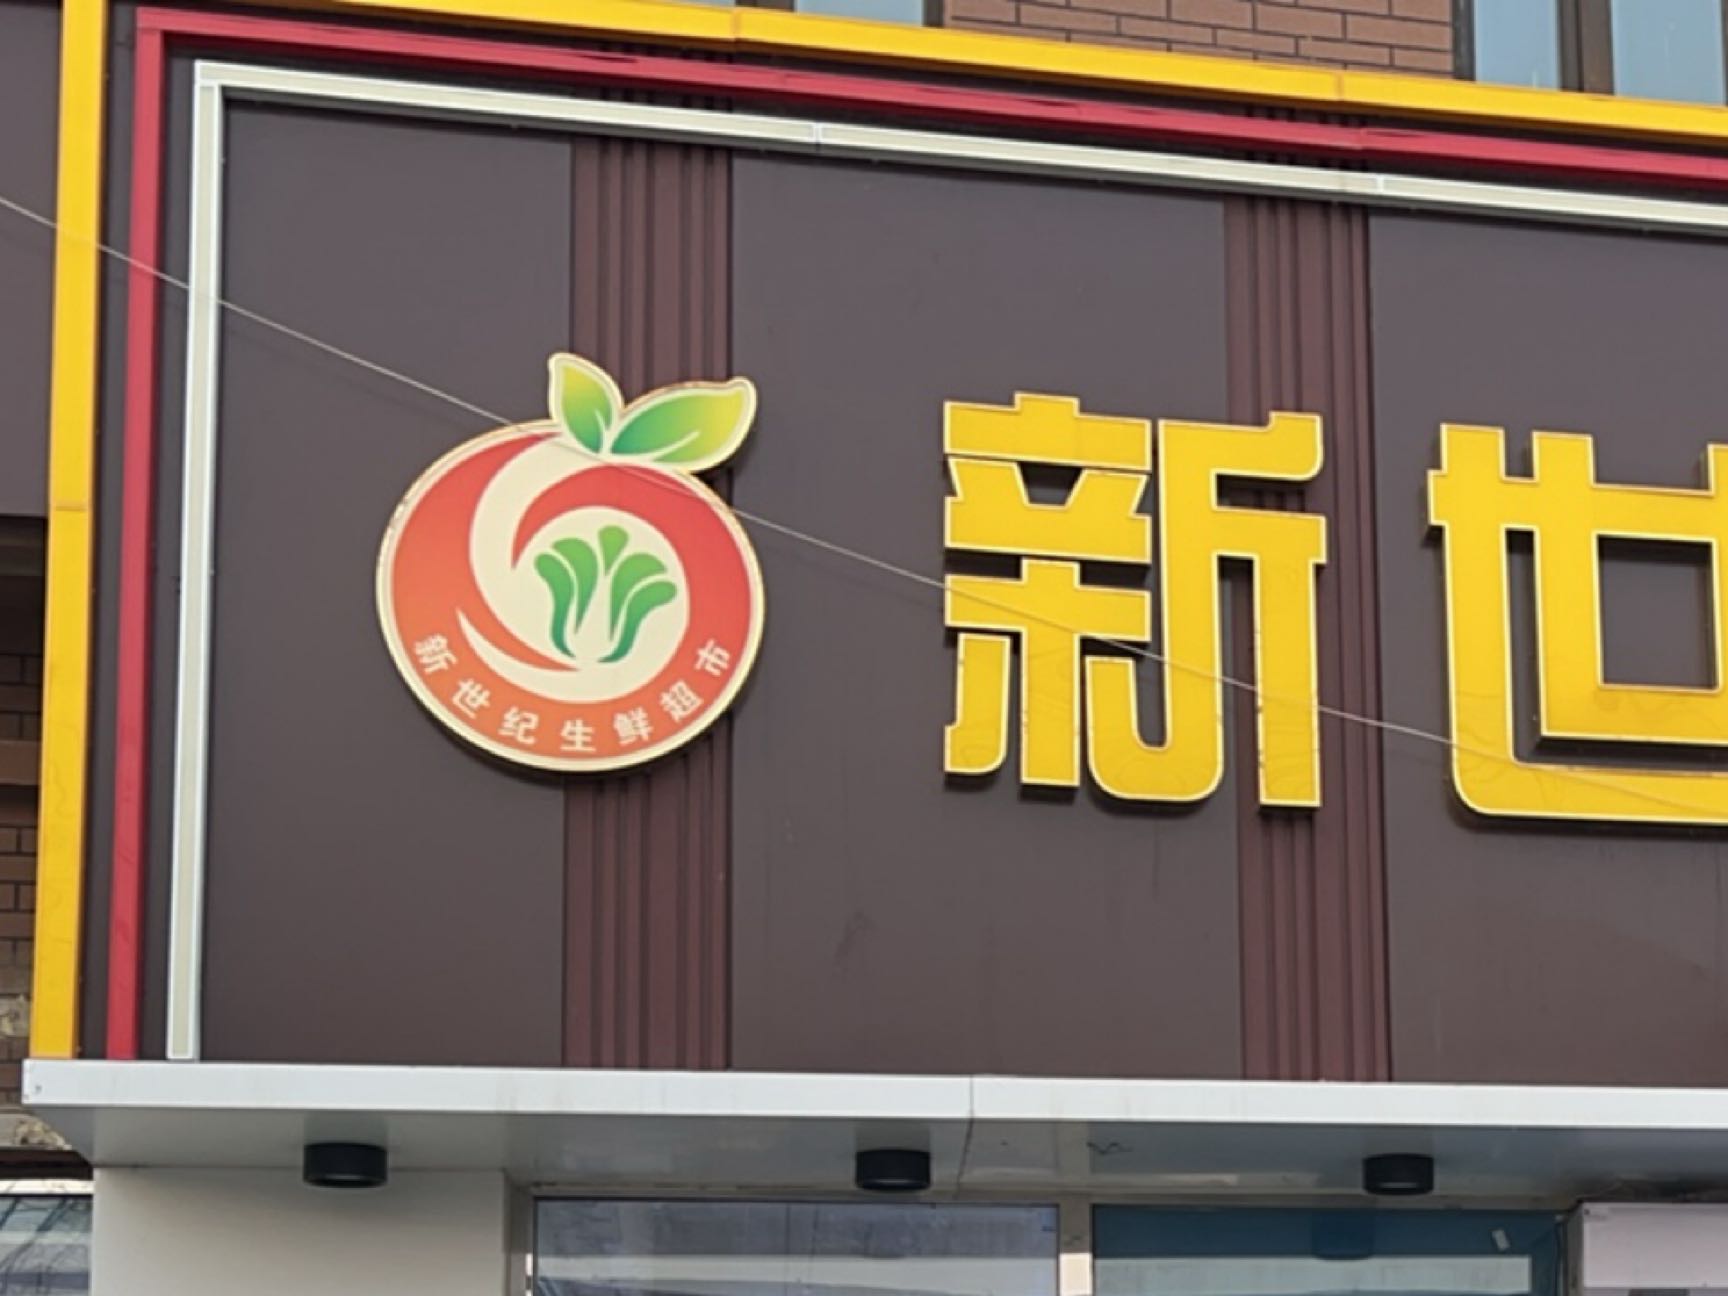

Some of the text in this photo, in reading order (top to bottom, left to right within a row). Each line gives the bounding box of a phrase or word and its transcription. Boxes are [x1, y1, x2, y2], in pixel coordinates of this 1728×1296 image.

[414, 633, 730, 753] 新世纪生鲜超市
